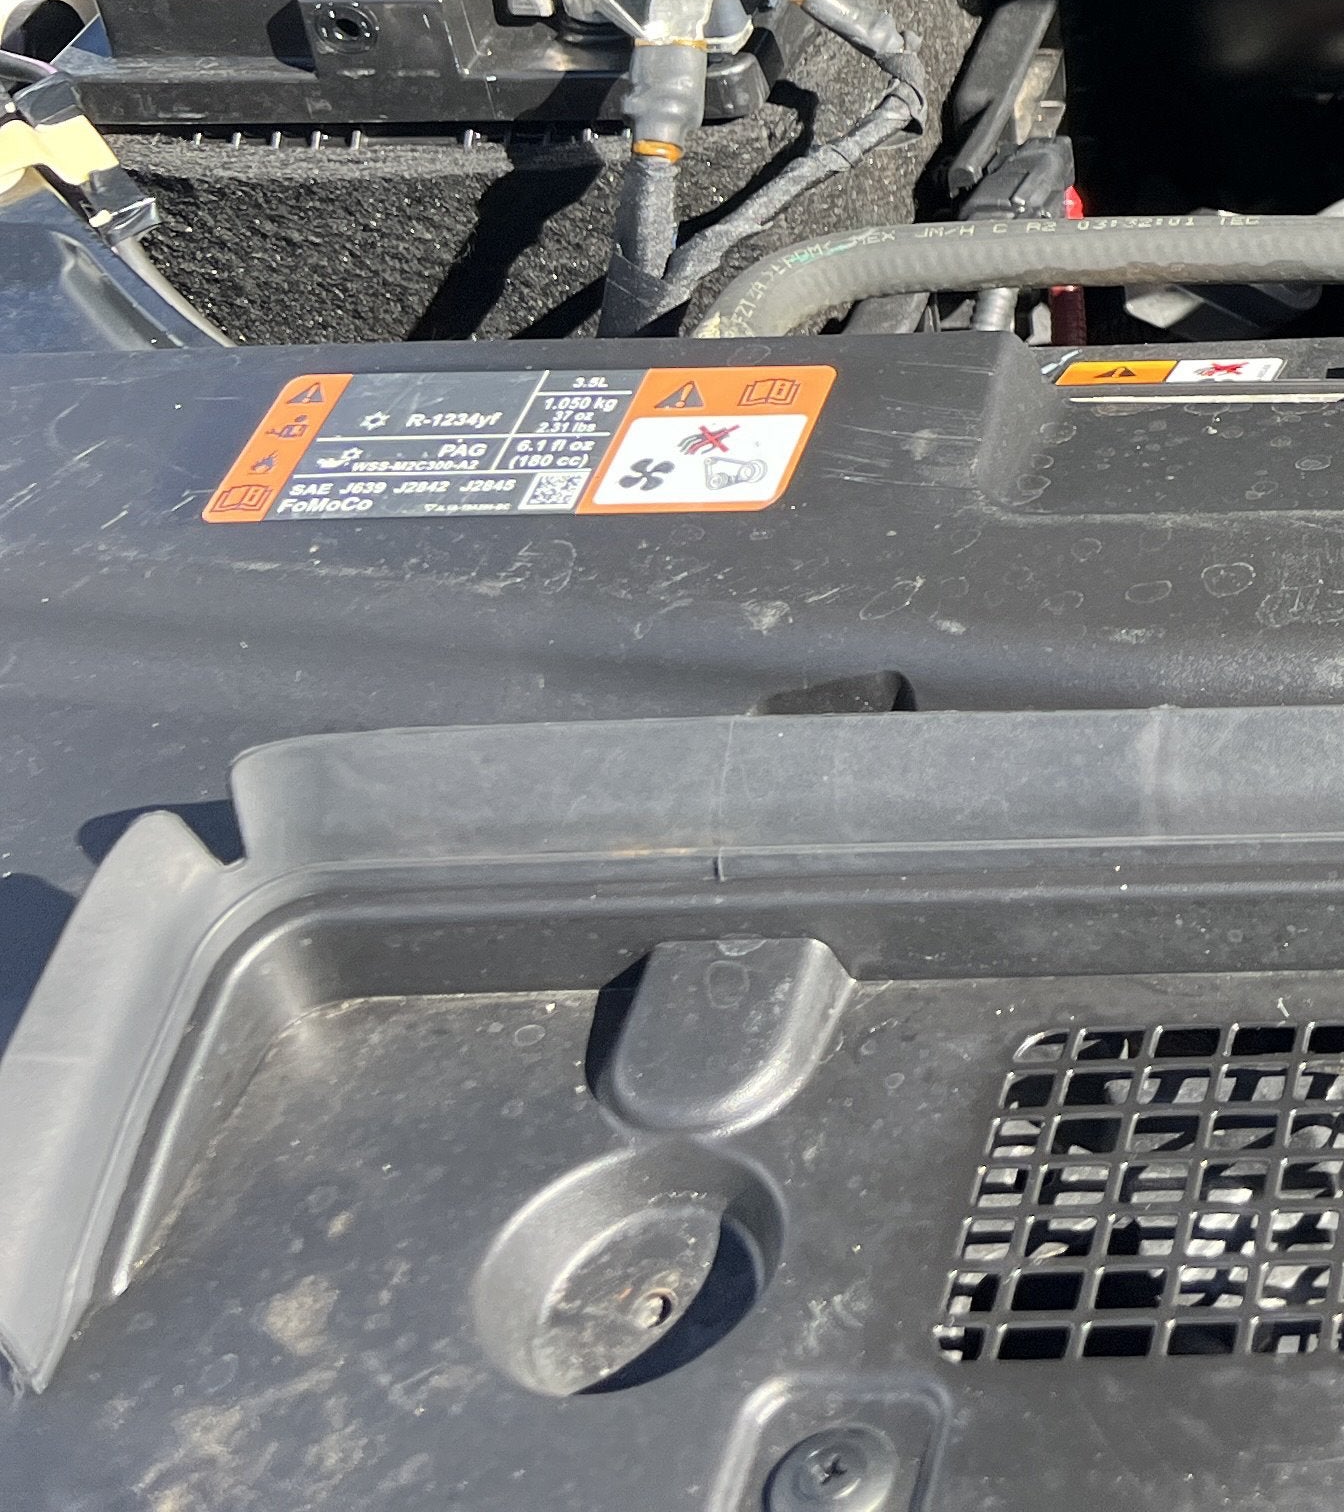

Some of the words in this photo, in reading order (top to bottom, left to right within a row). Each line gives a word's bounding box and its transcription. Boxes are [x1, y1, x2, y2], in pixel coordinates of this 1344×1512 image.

[572, 376, 609, 388] 3.5L
[544, 397, 590, 410] 1.050
[593, 396, 618, 412] kg
[405, 411, 503, 429] R-1234yf
[552, 411, 570, 422] 37
[574, 412, 595, 421] oz
[536, 423, 567, 433] 2.31
[571, 422, 597, 433] lbs
[437, 443, 488, 458] PAG
[516, 439, 547, 452] 6.1
[549, 439, 565, 452] fl
[569, 440, 596, 452] oz
[508, 454, 554, 469] (180
[556, 453, 589, 468] cc)
[289, 483, 334, 496] SAE
[338, 481, 388, 495] J639
[392, 480, 450, 494] J2842
[276, 496, 374, 514] FoMoCo
